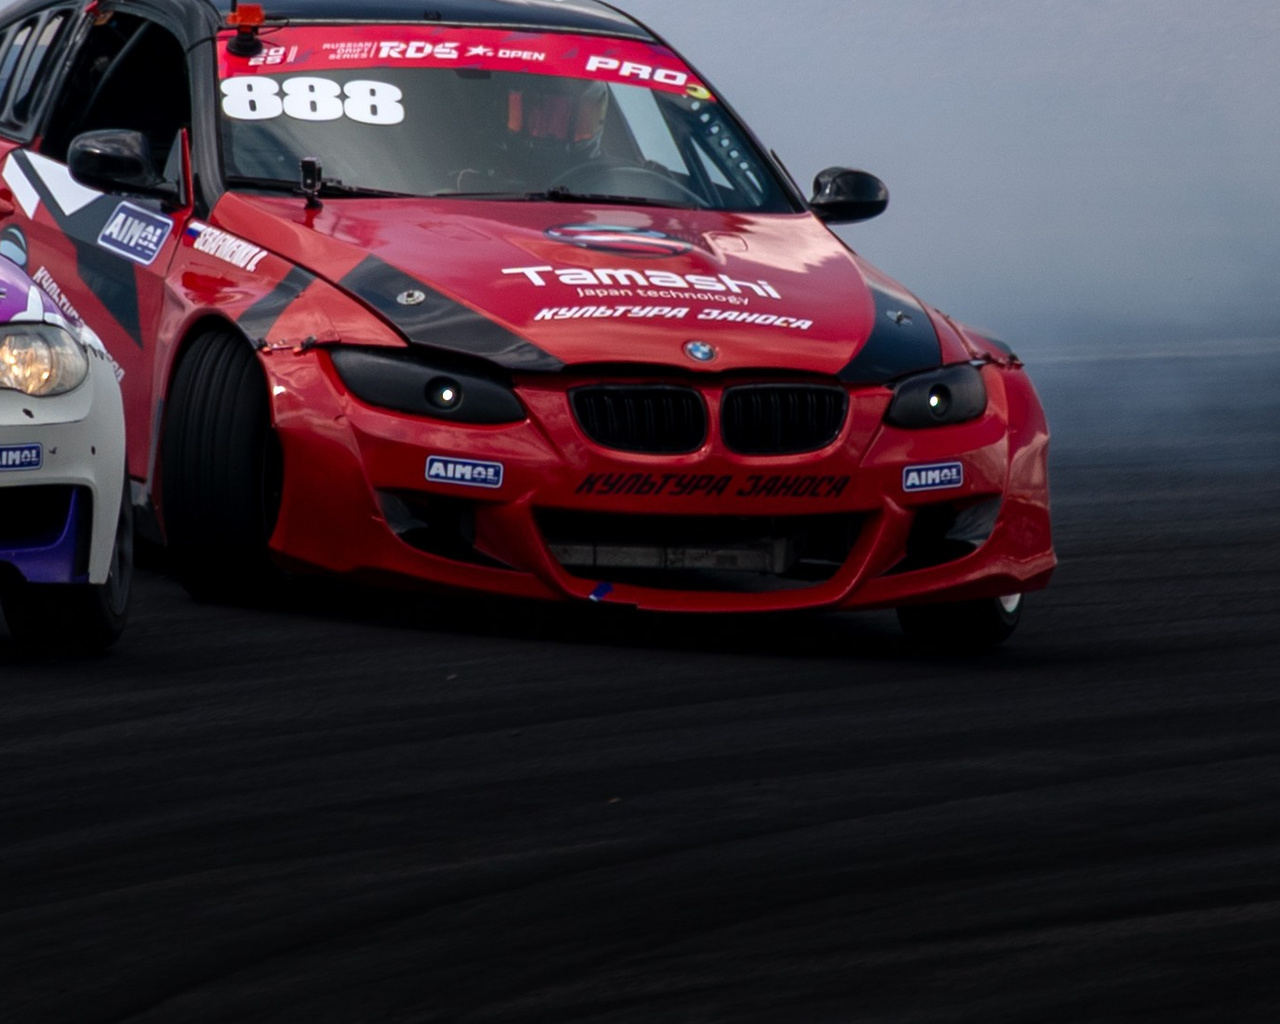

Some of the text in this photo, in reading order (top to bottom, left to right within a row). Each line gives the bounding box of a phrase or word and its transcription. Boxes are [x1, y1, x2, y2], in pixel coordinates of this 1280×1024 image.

[378, 41, 461, 59] RDS
[497, 49, 546, 61] OPEN
[586, 55, 689, 86] PRO
[220, 76, 405, 125] 888
[104, 212, 163, 252] AIMOL
[501, 265, 782, 299] Tamashi
[576, 287, 749, 305] Japan technology
[533, 305, 814, 330] КУЛЬТУРА ЗАНОСА
[429, 461, 498, 481] AIMOL
[906, 467, 960, 486] AIMOL
[575, 473, 851, 498] КУЛЬТУРА ЗАНОСА
